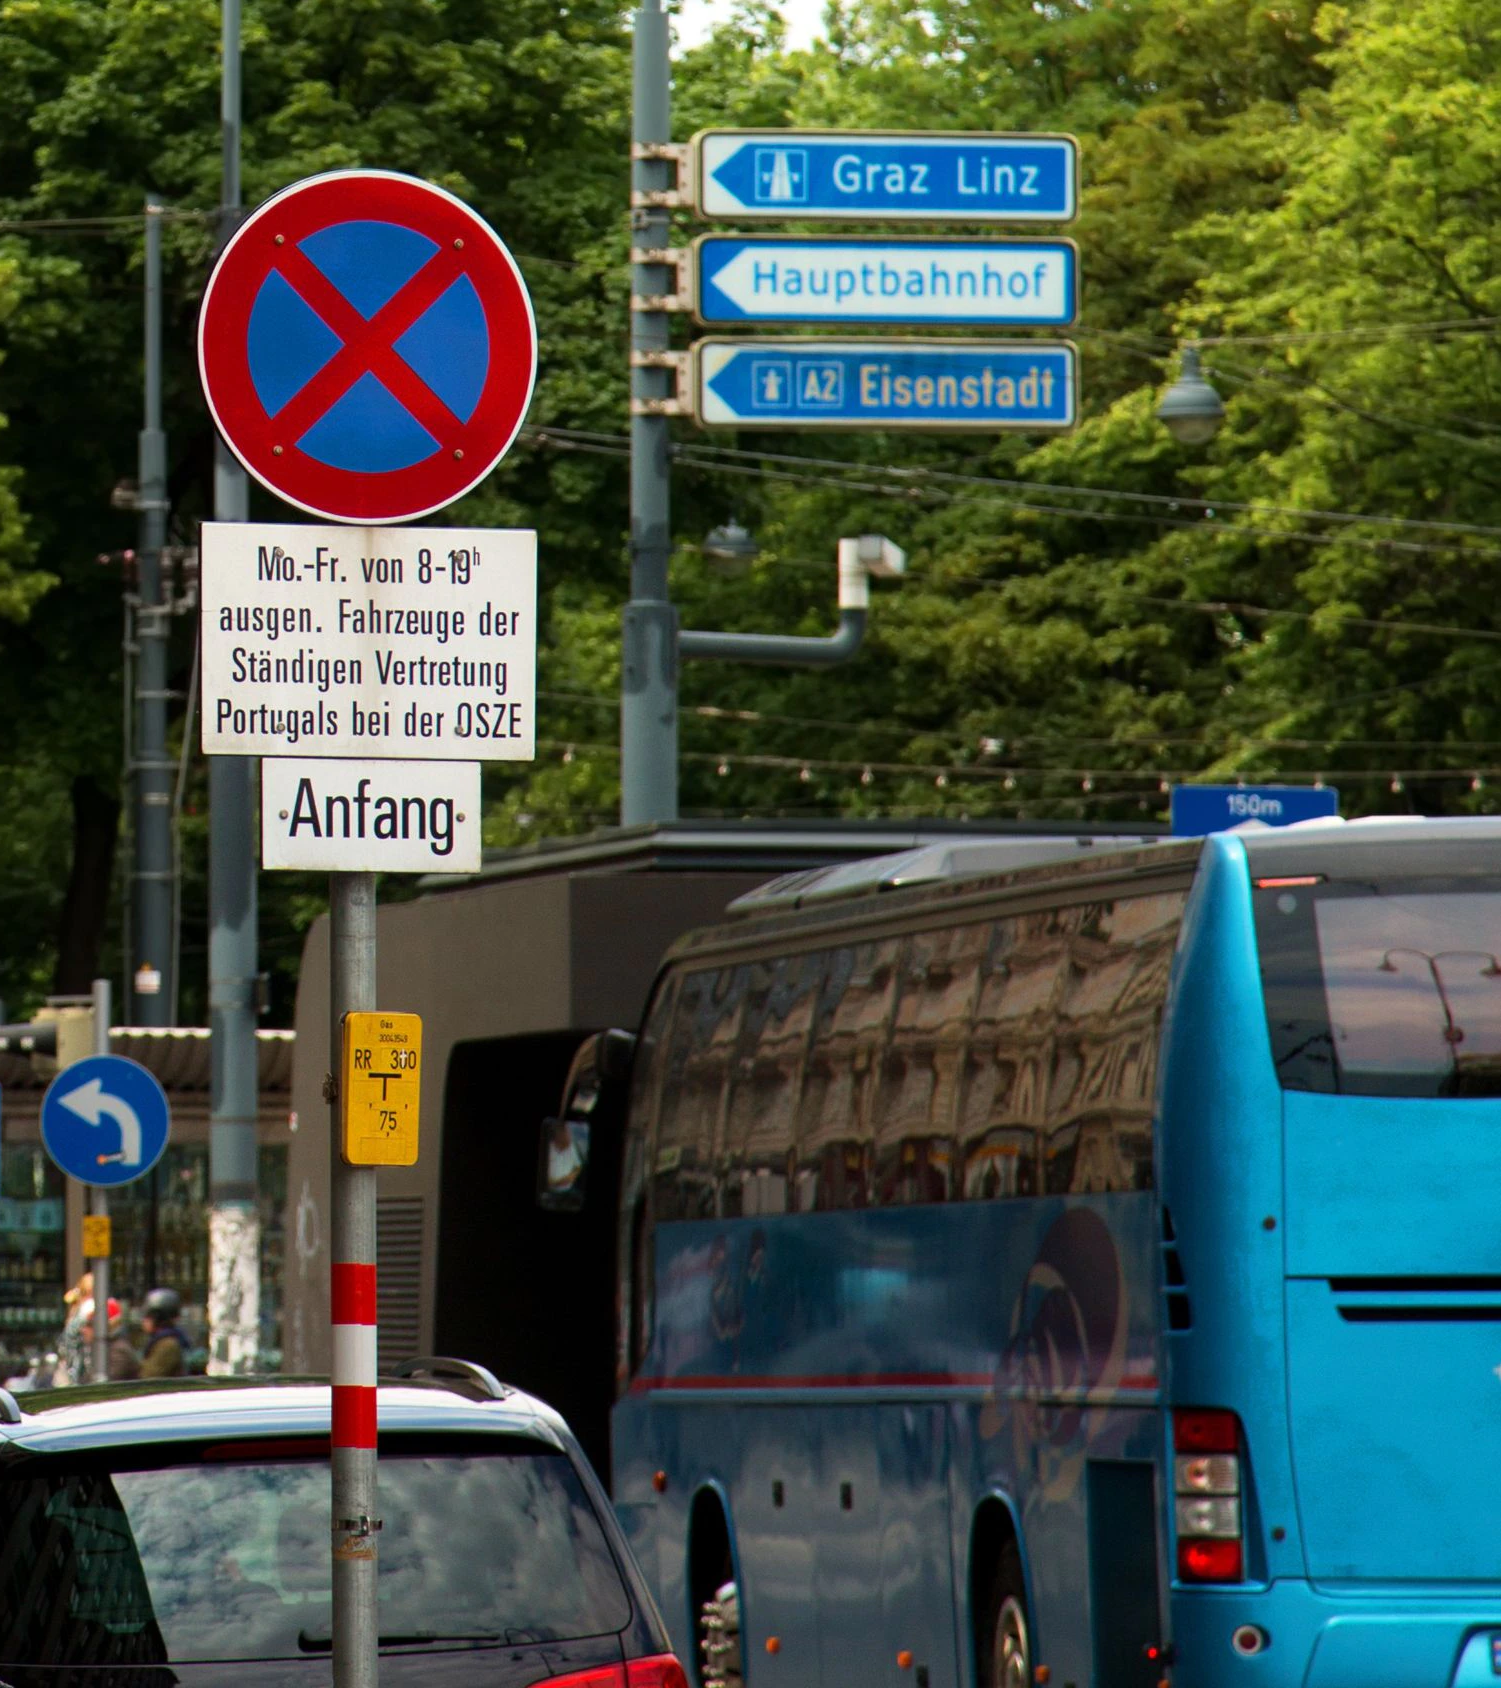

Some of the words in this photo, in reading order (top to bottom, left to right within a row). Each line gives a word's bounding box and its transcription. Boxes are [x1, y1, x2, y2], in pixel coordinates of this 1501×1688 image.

[833, 154, 930, 195] Graz
[957, 157, 1040, 195] Linz
[752, 260, 1047, 303] Hauptbahnhof
[803, 366, 837, 402] A2
[859, 363, 1053, 409] Eisenstadt
[258, 546, 347, 582] Mo.-Fr.
[361, 557, 403, 583] von
[220, 607, 322, 640] ausgen.
[339, 599, 465, 644] Fahrzeuge
[479, 601, 519, 636] der
[232, 647, 362, 692] Ständigen
[376, 651, 507, 695] Vertretung
[217, 698, 338, 743] Portugals
[352, 701, 389, 737] bei
[404, 702, 444, 737] der
[454, 702, 521, 738] OSZE
[289, 778, 454, 856] Anfang
[1227, 794, 1283, 816] 150m
[380, 1020, 393, 1029] Gas
[355, 1049, 371, 1069] RR
[380, 1111, 397, 1130] 75
